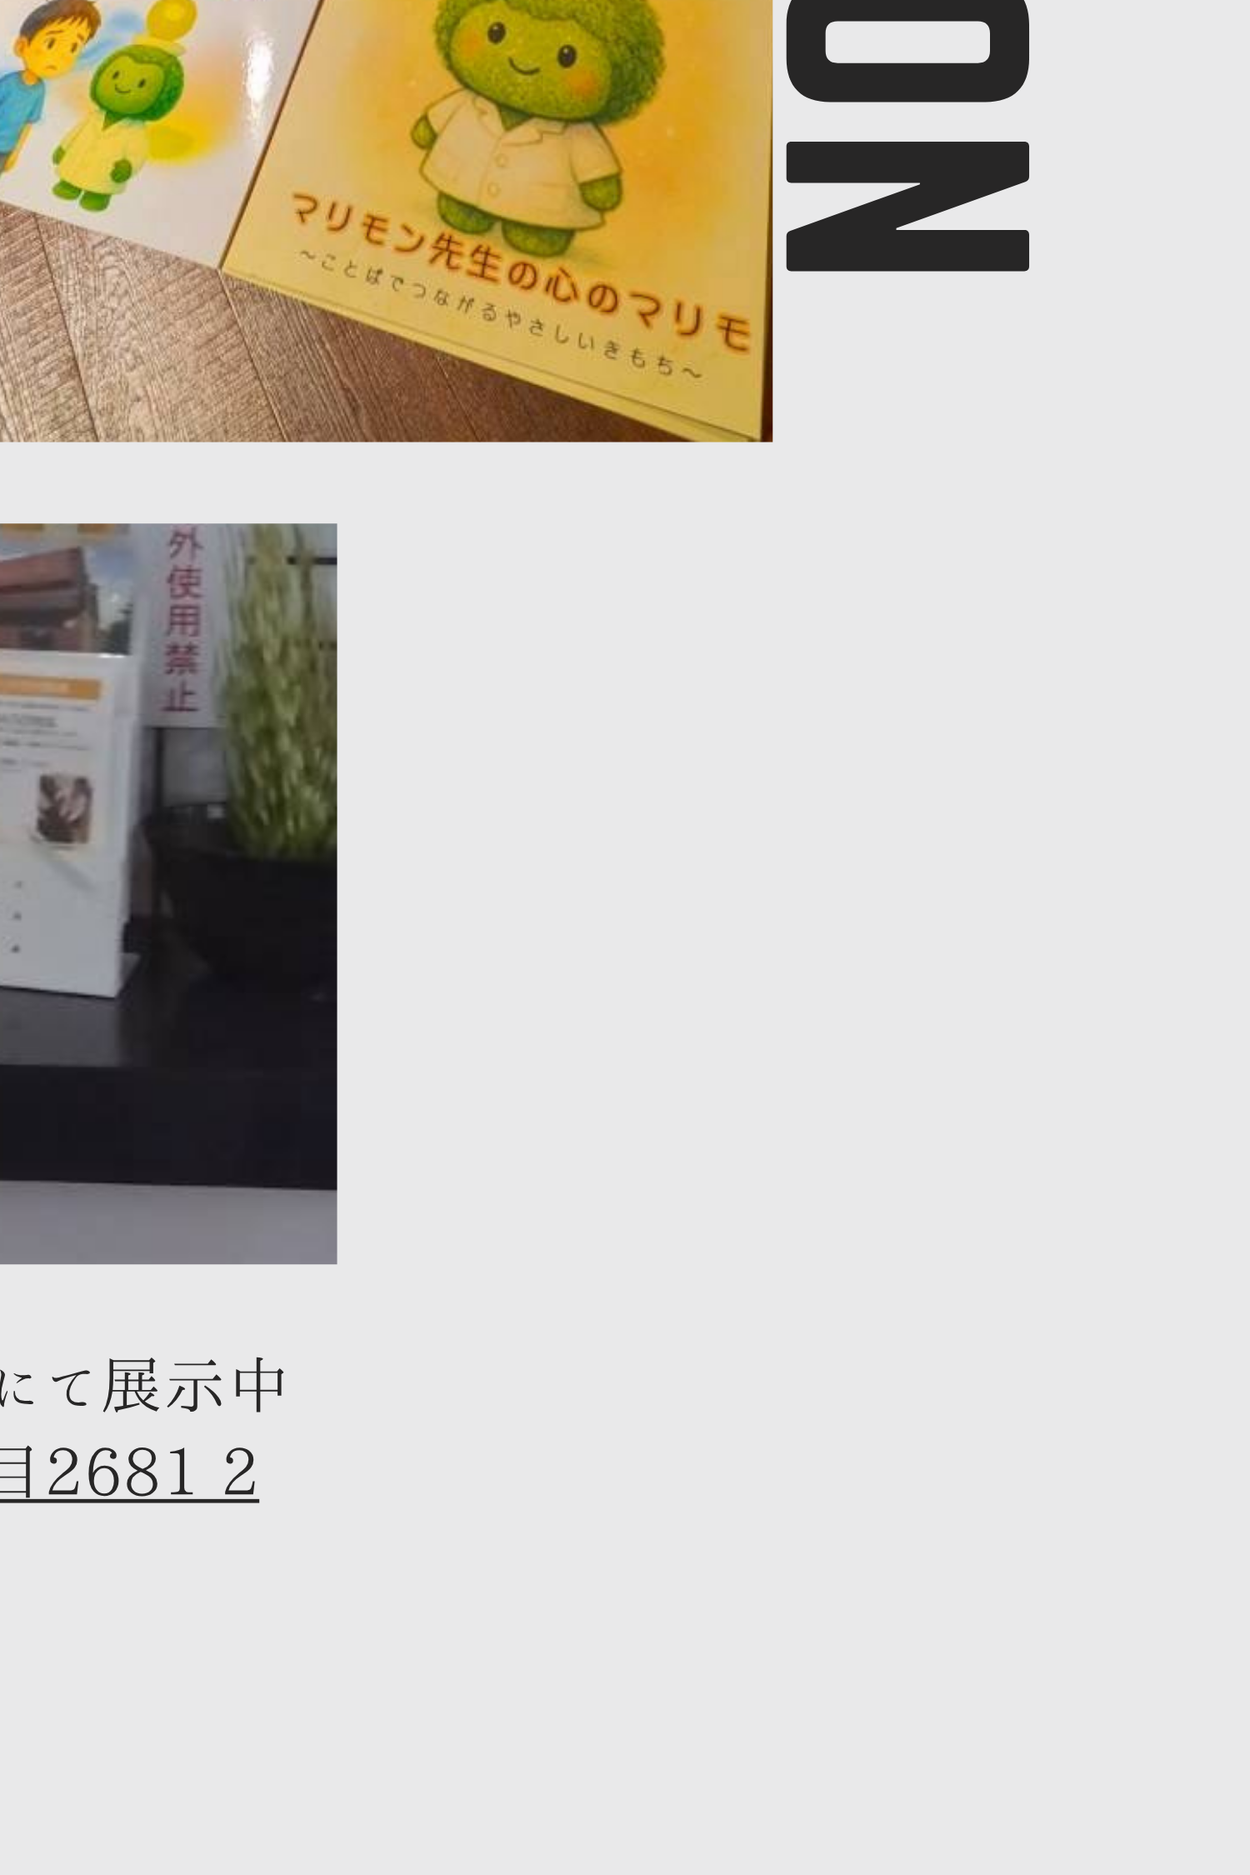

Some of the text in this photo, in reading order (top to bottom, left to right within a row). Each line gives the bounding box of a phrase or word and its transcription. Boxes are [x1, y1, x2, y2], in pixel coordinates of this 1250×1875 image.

[291, 191, 752, 355] マリモン先生の心のマリモ
